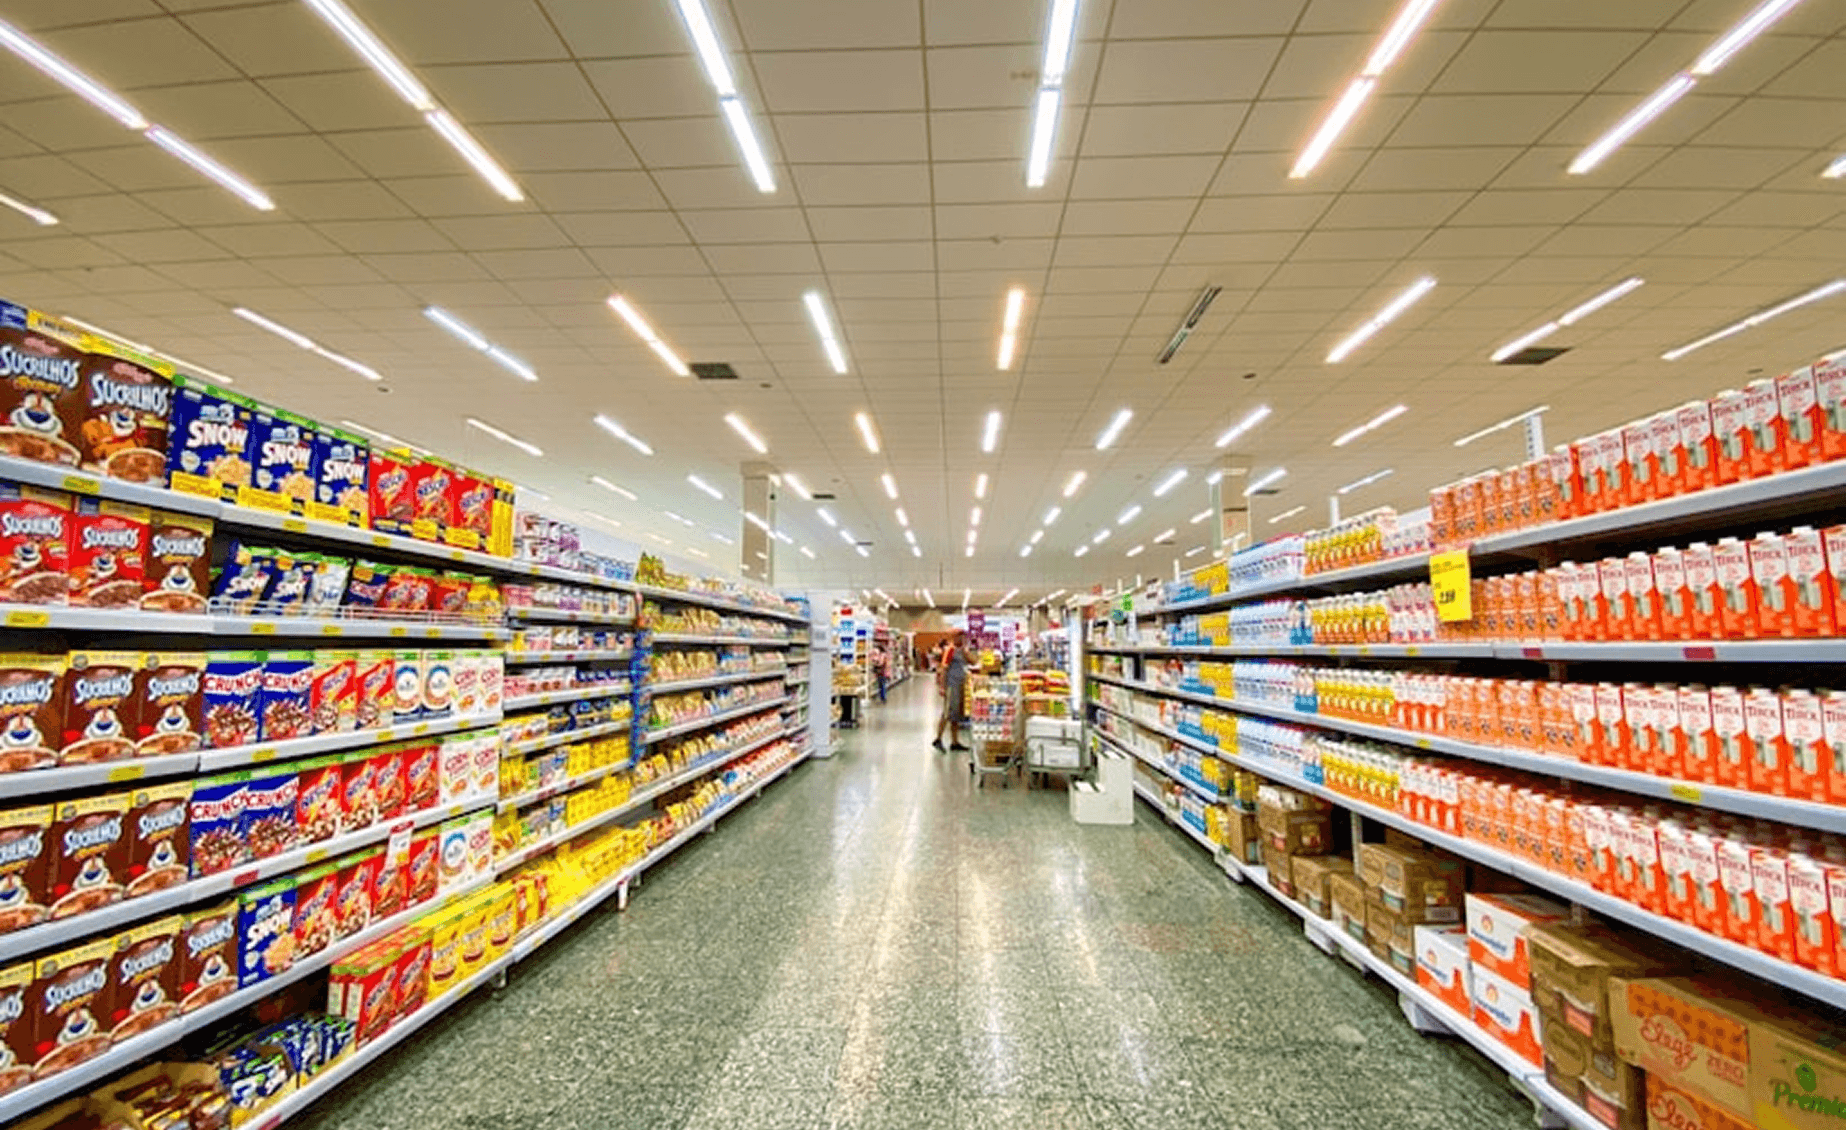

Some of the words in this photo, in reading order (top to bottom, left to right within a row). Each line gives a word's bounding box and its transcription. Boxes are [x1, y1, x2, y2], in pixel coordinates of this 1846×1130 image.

[0, 345, 80, 389] SUCRILHOS
[90, 372, 170, 417] SUCRILHOS
[187, 420, 249, 452] SNOW
[261, 441, 311, 470] SNOW
[322, 460, 365, 485] SNOW
[2, 511, 63, 539] SUCRILHOS
[82, 525, 139, 550] SUCRILHOS
[152, 533, 206, 558] SUCRILHOS
[74, 671, 134, 705] SUCRILHOS
[147, 670, 201, 702] SUCRILHOS
[203, 670, 262, 692] CRUNCH
[191, 790, 247, 820] CRUNCH
[63, 814, 124, 858] SUCRILHOS
[137, 802, 188, 841] SUCRILHOS
[120, 936, 175, 985] SUCRILHOS
[45, 961, 108, 1014] SUCRILHOS
